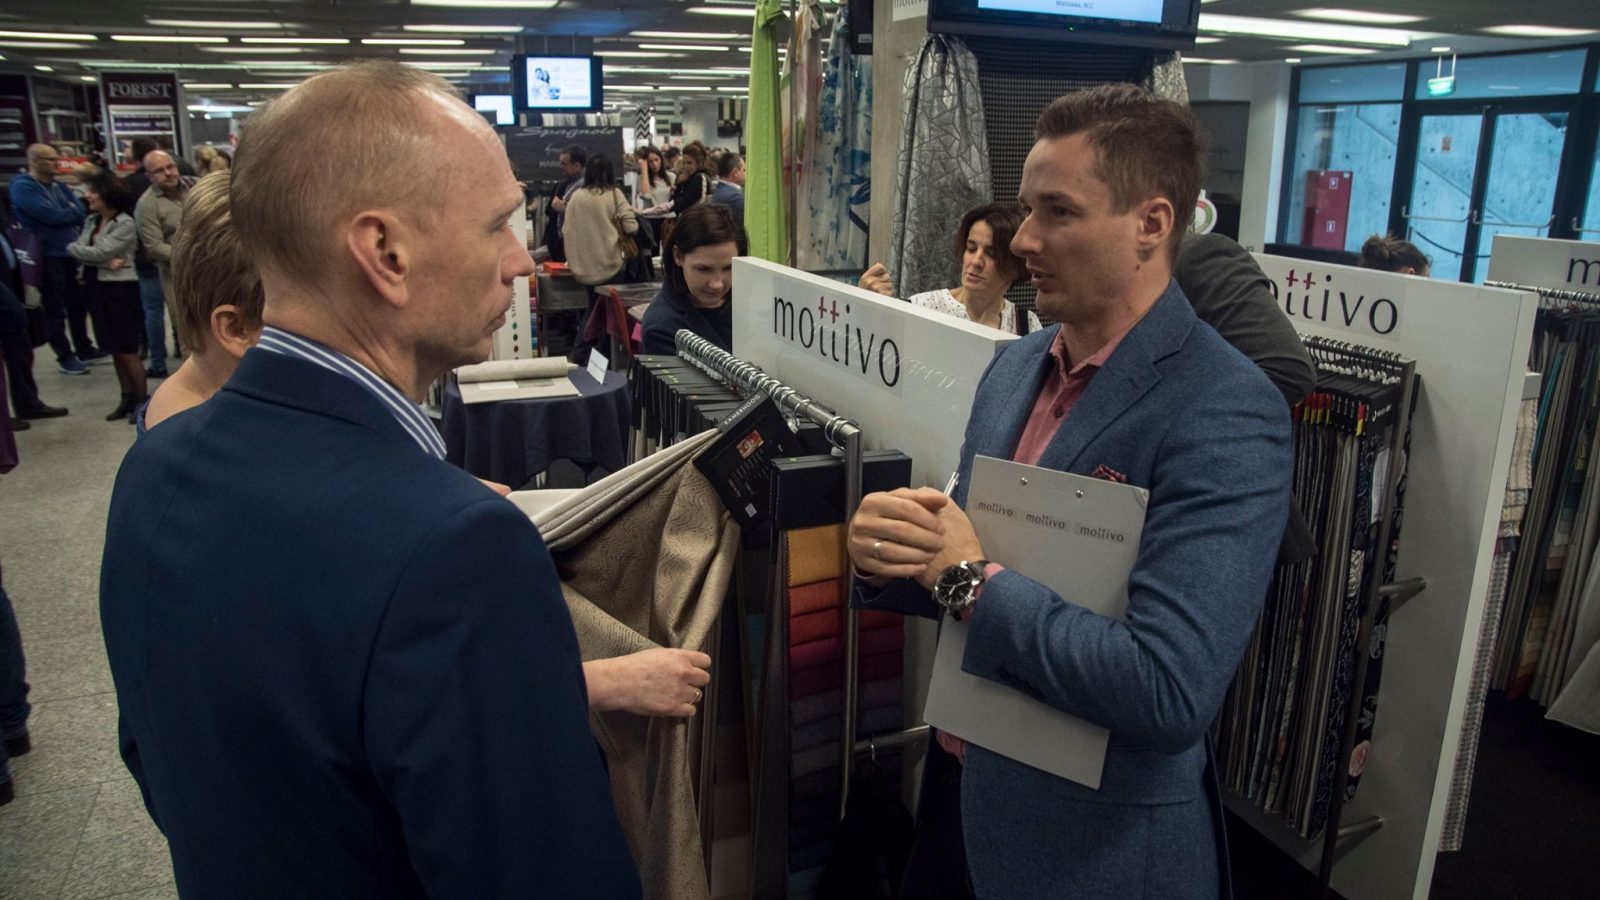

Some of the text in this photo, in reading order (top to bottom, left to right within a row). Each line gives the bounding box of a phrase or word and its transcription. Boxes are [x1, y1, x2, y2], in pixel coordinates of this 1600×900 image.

[108, 82, 173, 98] FOREST
[1268, 268, 1398, 335] ttivo
[774, 296, 900, 387] mottivo
[978, 501, 1125, 543] mottivo mottivo mottivo
